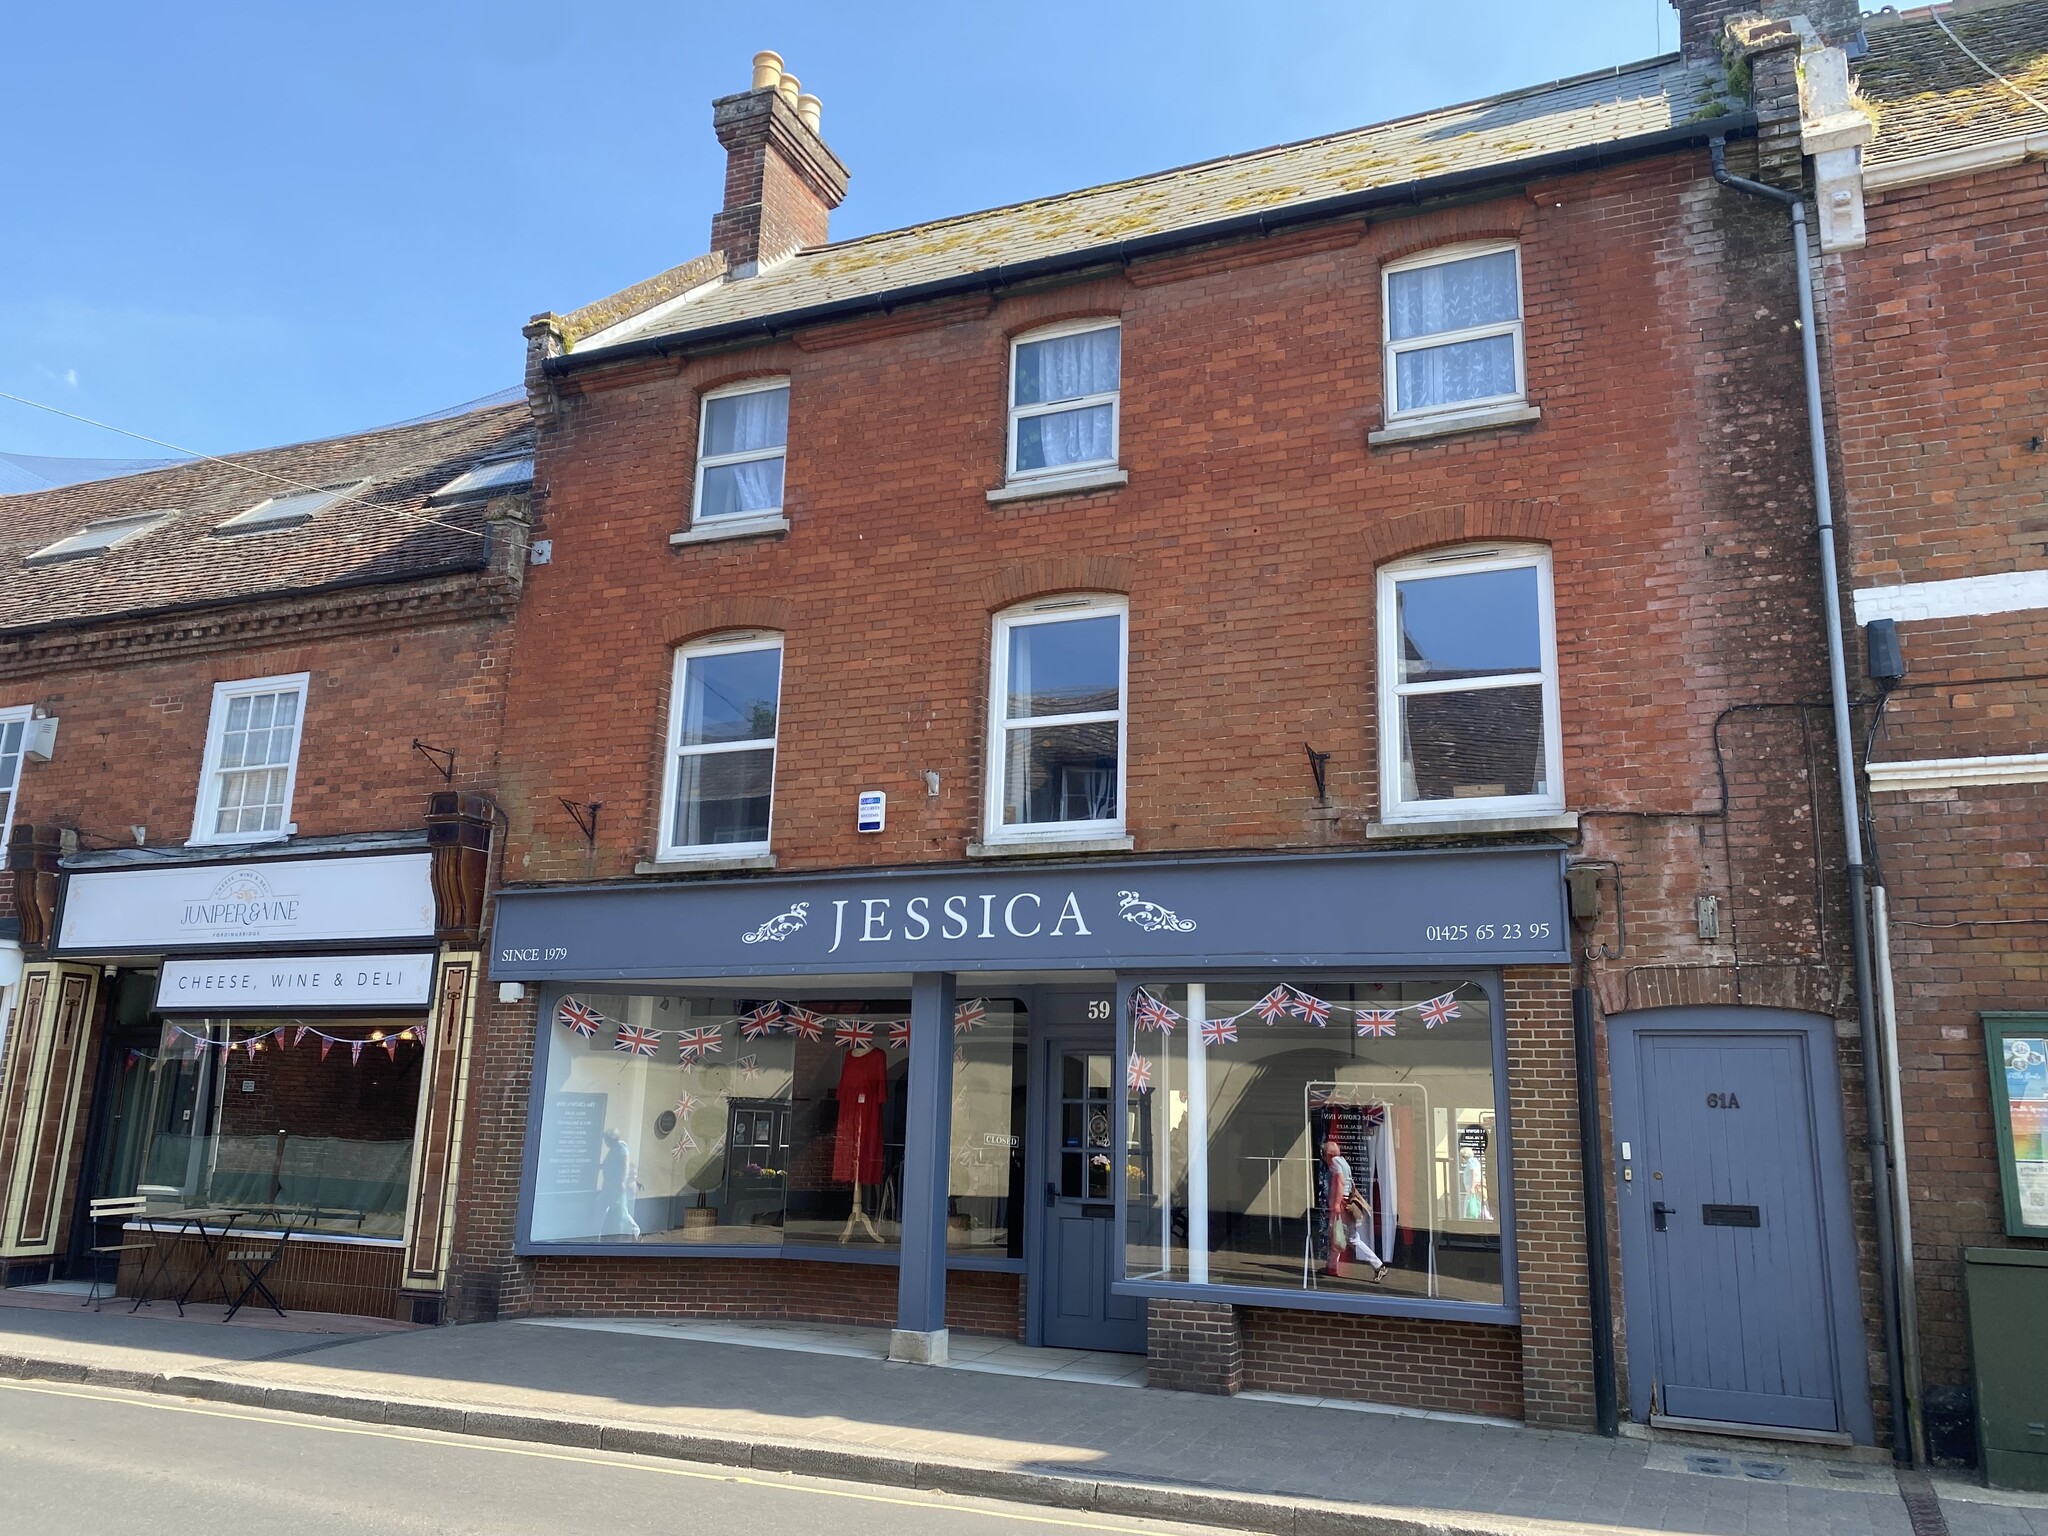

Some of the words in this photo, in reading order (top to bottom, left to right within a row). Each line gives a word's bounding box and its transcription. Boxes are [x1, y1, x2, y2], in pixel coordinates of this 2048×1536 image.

[828, 891, 1092, 954] JESSICA
[1426, 924, 1468, 941] 01425
[1476, 924, 1495, 940] 65
[1502, 923, 1522, 939] 23
[1529, 922, 1550, 939] 95
[501, 948, 540, 962] SINCE
[544, 947, 567, 961] 1979
[178, 975, 257, 990] CHEESE,
[271, 973, 321, 987] WINE
[333, 972, 343, 987] &
[357, 971, 402, 986] DELI
[1088, 1000, 1111, 1019] 59
[1706, 1092, 1741, 1109] 61A
[985, 1135, 1017, 1146] CLOSED
